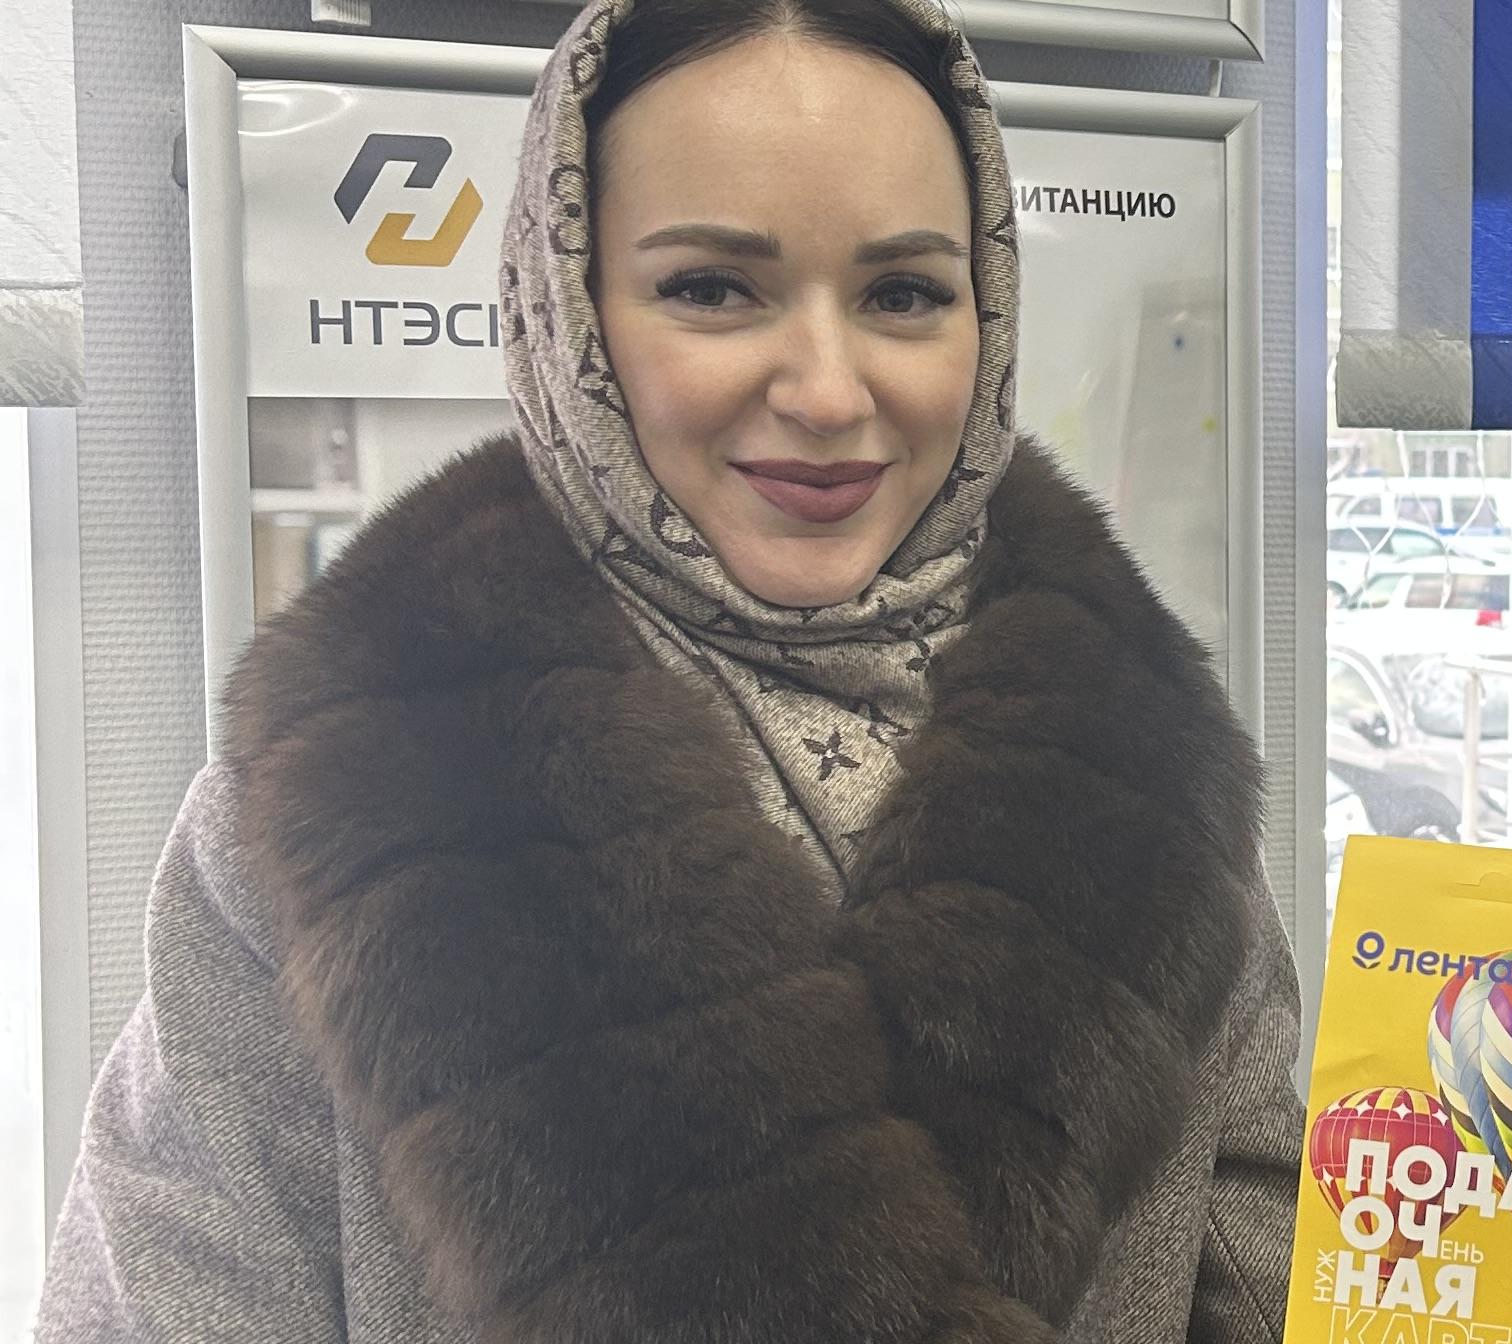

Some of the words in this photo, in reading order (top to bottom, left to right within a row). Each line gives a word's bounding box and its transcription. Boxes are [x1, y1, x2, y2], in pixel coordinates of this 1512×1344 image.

[1013, 186, 1176, 221] ИТАНЦИЮ
[1340, 1196, 1442, 1258] ОЧ
[1440, 1239, 1484, 1265] ЕНЬ
[1313, 1248, 1335, 1303] НУЖ
[1334, 1250, 1477, 1319] НАЯ
